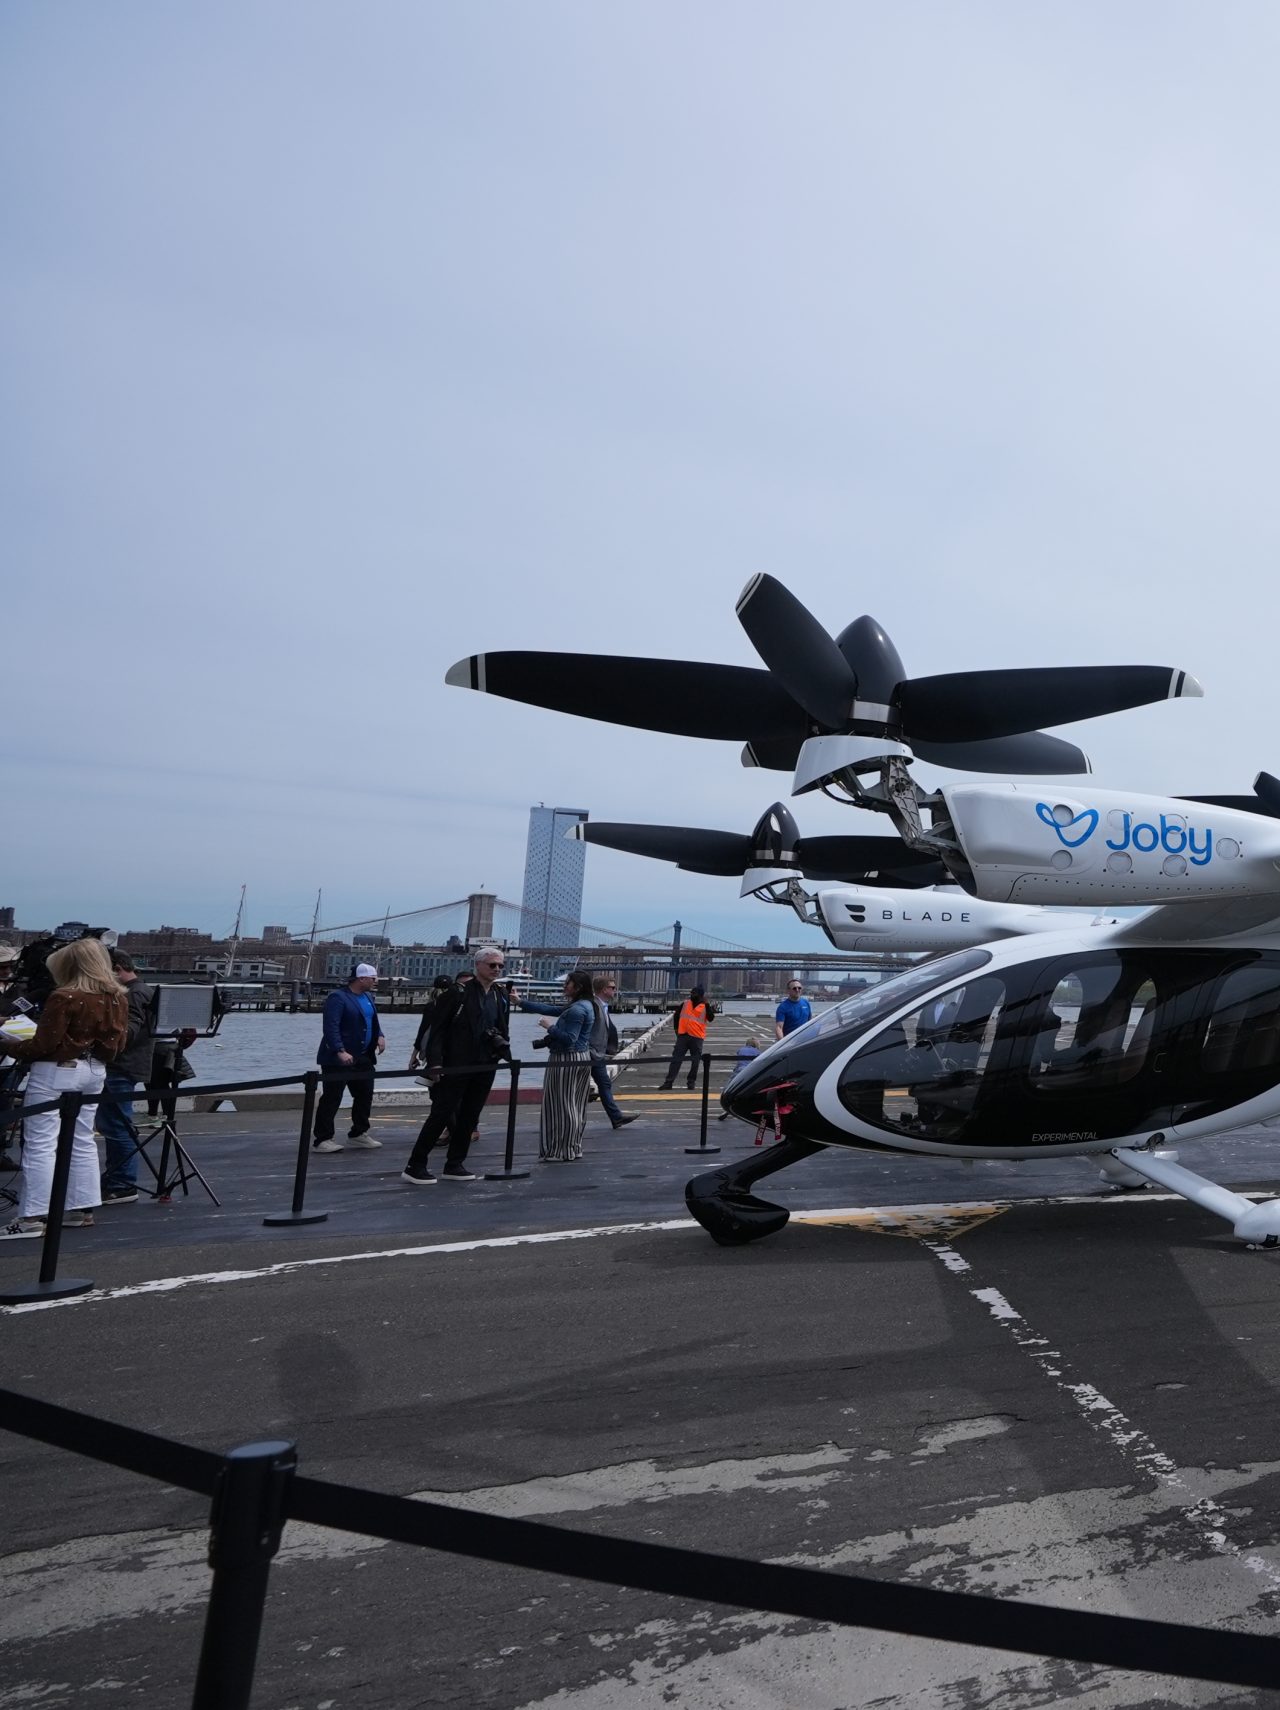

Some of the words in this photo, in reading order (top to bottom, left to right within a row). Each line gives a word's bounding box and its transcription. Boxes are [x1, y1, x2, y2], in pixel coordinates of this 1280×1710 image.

[1106, 813, 1212, 866] Joby
[882, 910, 971, 923] BLADE
[1031, 1131, 1099, 1142] EXPERIMENTAL
